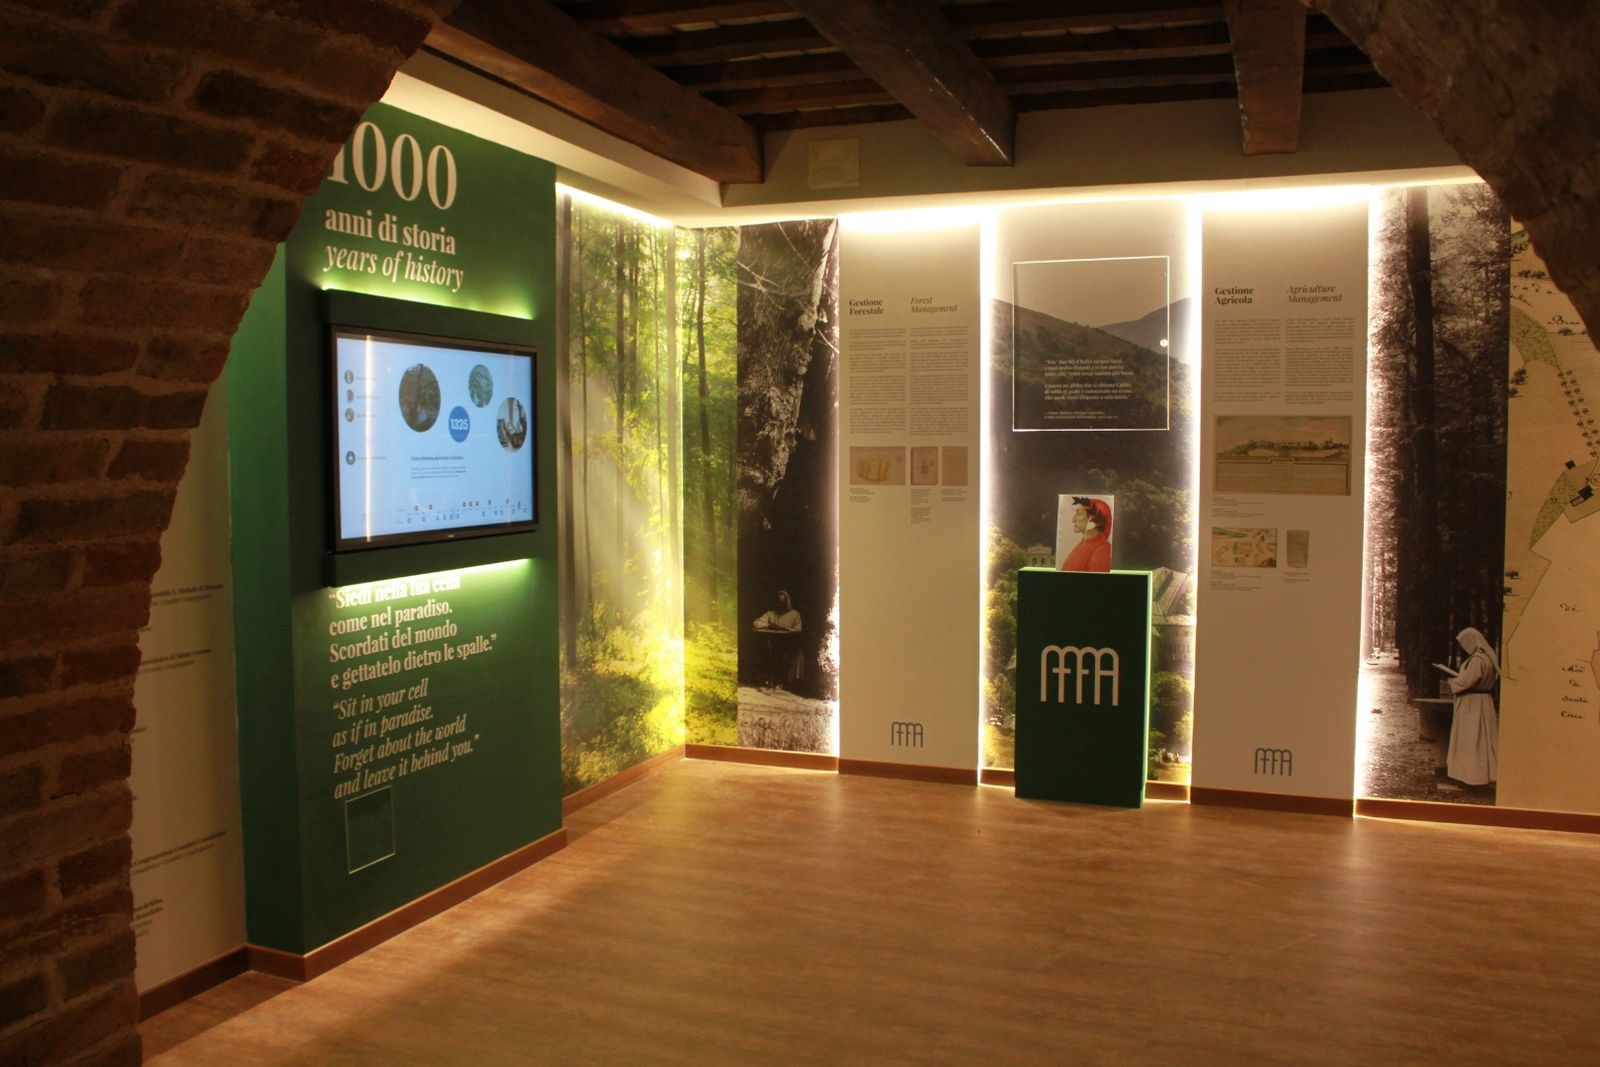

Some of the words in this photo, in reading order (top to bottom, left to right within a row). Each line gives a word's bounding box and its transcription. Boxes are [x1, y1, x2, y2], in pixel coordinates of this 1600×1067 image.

[325, 209, 373, 238] anni
[378, 213, 398, 243] di
[402, 224, 456, 255] storia
[323, 246, 378, 274] years
[382, 250, 404, 283] of
[404, 252, 464, 293] history
[910, 296, 934, 305] Forest
[1214, 286, 1255, 295] Gestione
[1214, 296, 1253, 305] Agricola
[1287, 284, 1336, 294] Agriculture
[1287, 294, 1343, 304] Management
[849, 298, 883, 307] Gestione
[849, 306, 885, 315] Forestale
[910, 304, 958, 314] Management
[450, 417, 469, 431] 1325
[329, 616, 368, 636] come
[371, 606, 392, 628] nel
[395, 599, 453, 627] paradiso.
[329, 632, 389, 663] Scordati
[392, 627, 411, 648] del
[415, 620, 457, 643] mondo
[330, 673, 340, 689] e
[342, 656, 401, 690] gettatelo
[404, 650, 442, 671] dietro
[444, 643, 455, 661] le
[360, 694, 374, 714] in
[375, 688, 406, 714] your
[408, 677, 429, 701] cell
[332, 729, 348, 748] as
[350, 720, 363, 745] if
[364, 718, 377, 738] in
[379, 704, 434, 737] paradise.
[333, 745, 375, 774] Forget
[377, 734, 412, 760] about
[414, 726, 433, 747] the
[434, 713, 467, 741] world
[334, 772, 361, 799] and
[363, 765, 396, 789] leave
[398, 758, 408, 777] it
[410, 742, 450, 773] behind
